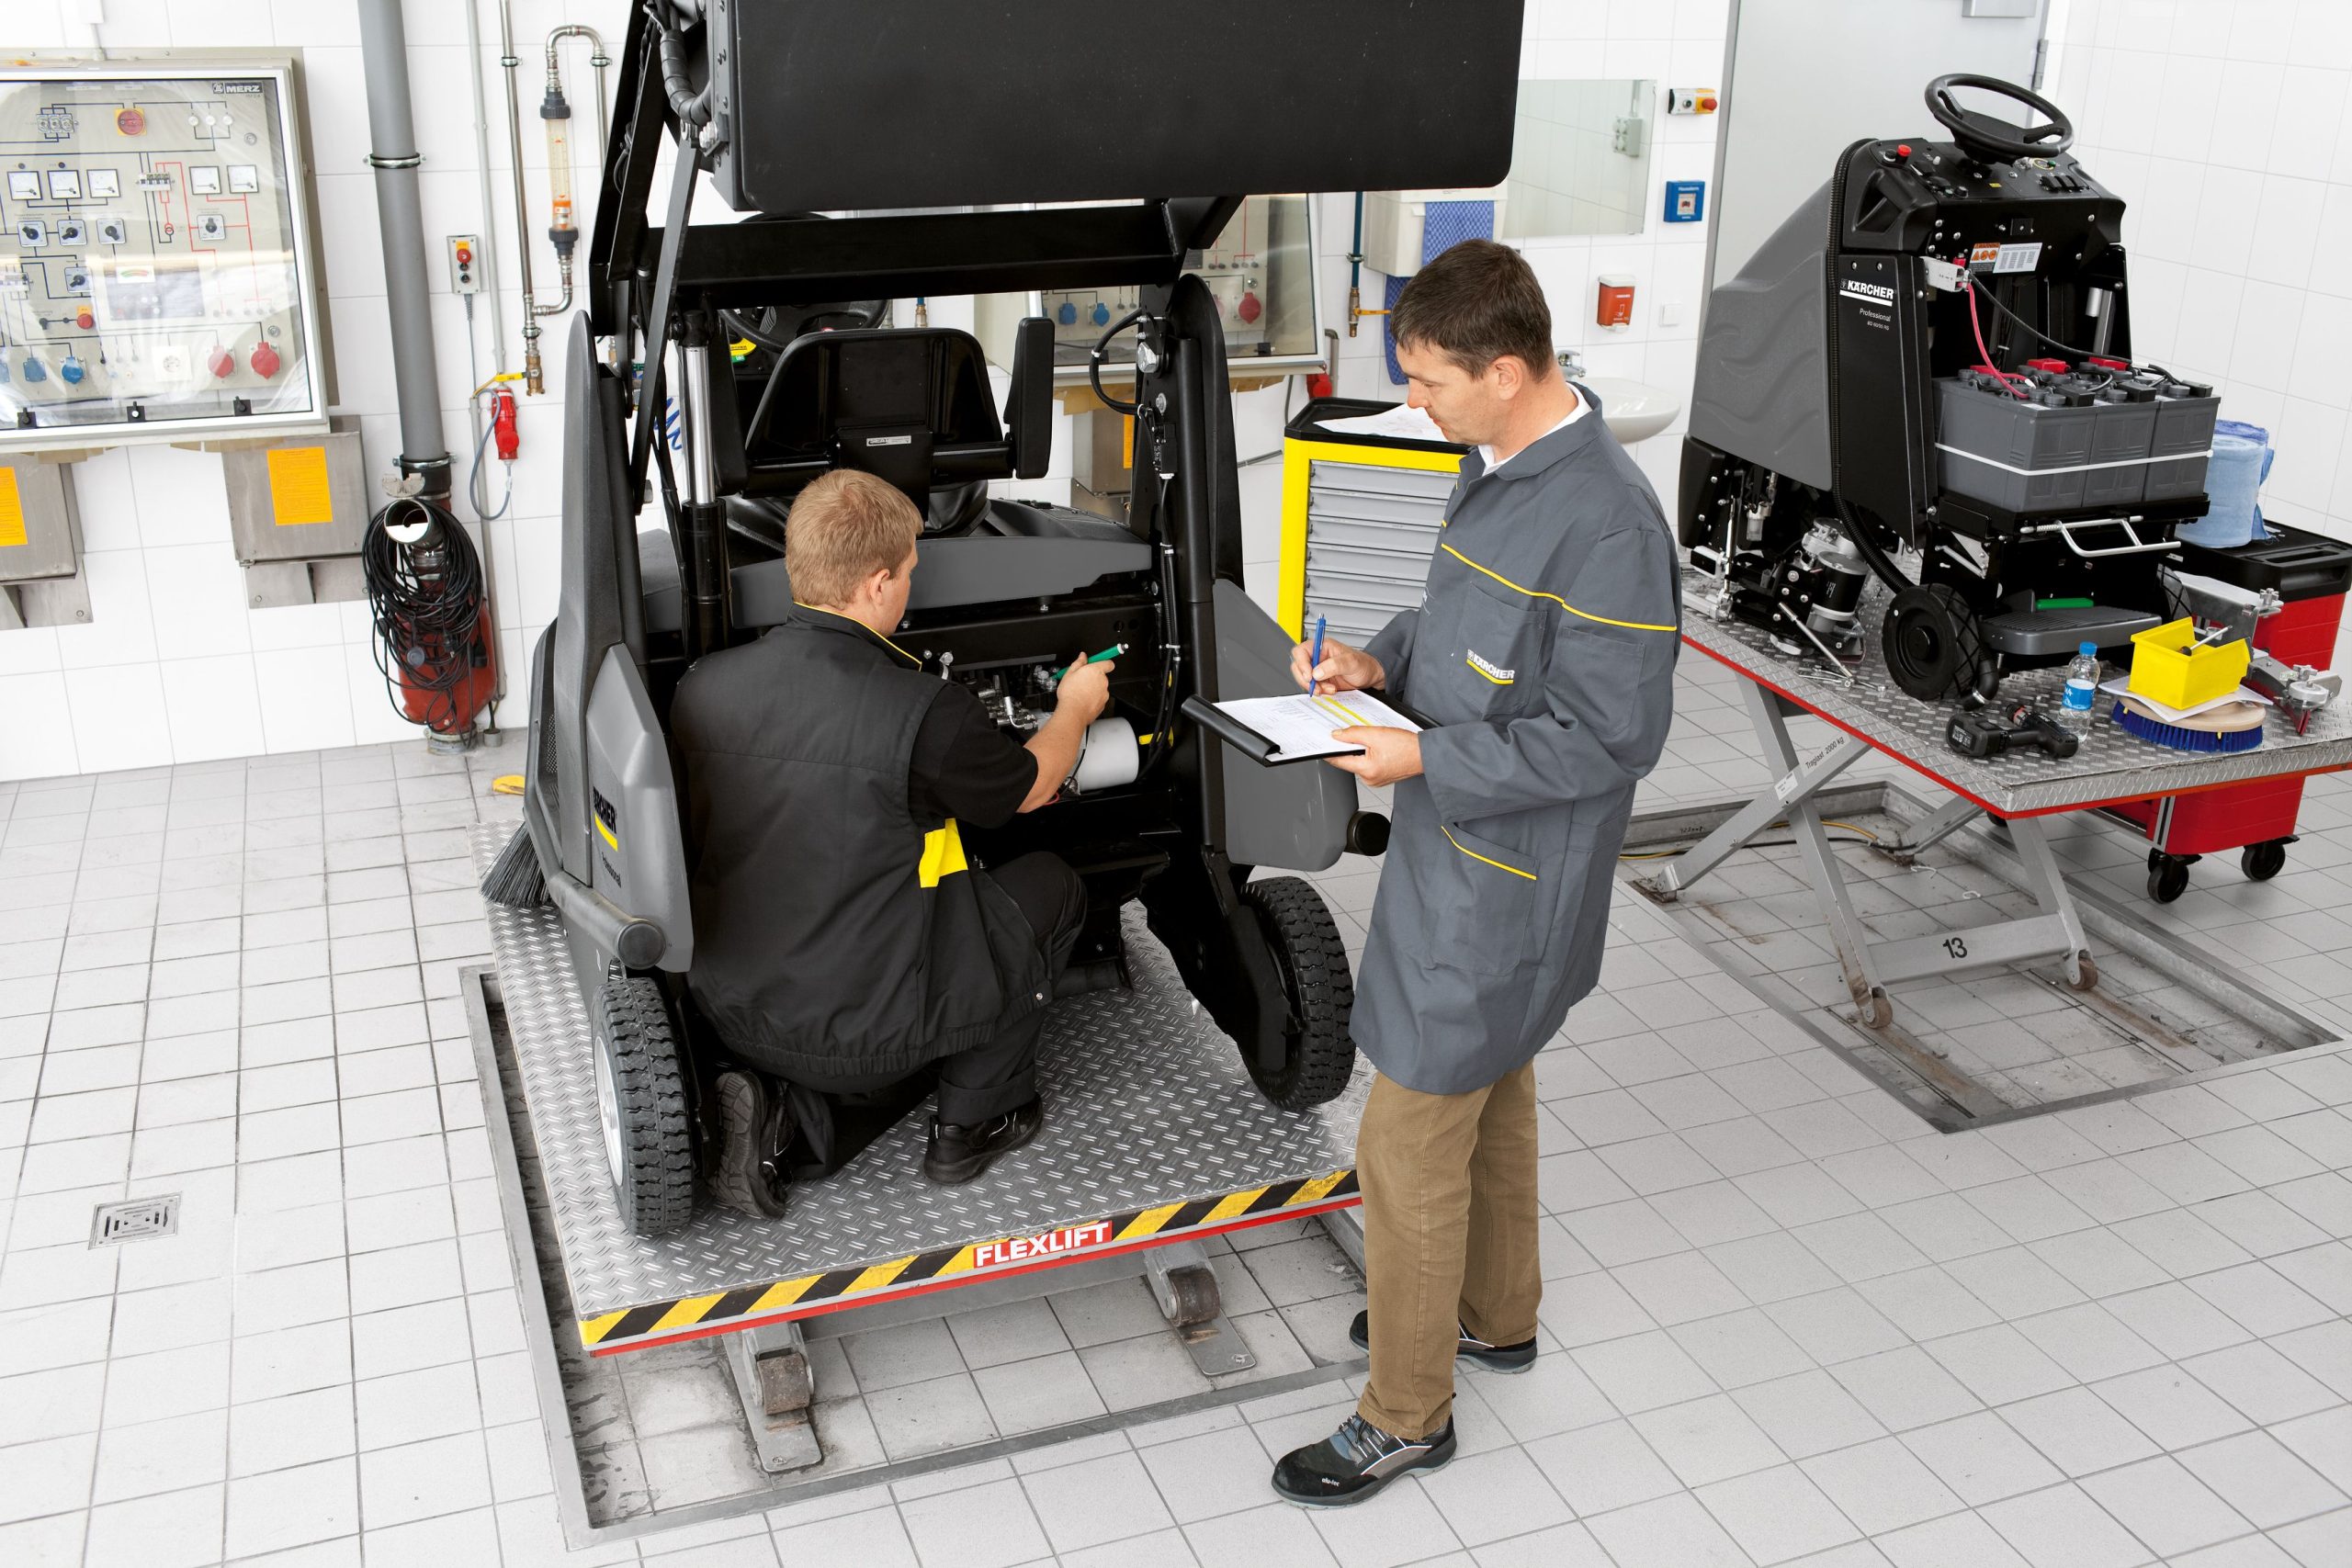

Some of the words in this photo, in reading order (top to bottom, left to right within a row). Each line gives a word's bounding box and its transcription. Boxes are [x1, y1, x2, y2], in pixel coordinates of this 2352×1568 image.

[1848, 280, 1894, 299] KÄRCHER
[1860, 308, 1891, 321] Professional
[1805, 751, 1825, 769] Traglast
[1825, 741, 1838, 754] 2000
[1837, 737, 1845, 745] kg
[1942, 937, 1968, 959] 13
[976, 1223, 1110, 1267] FLEXLIFT
